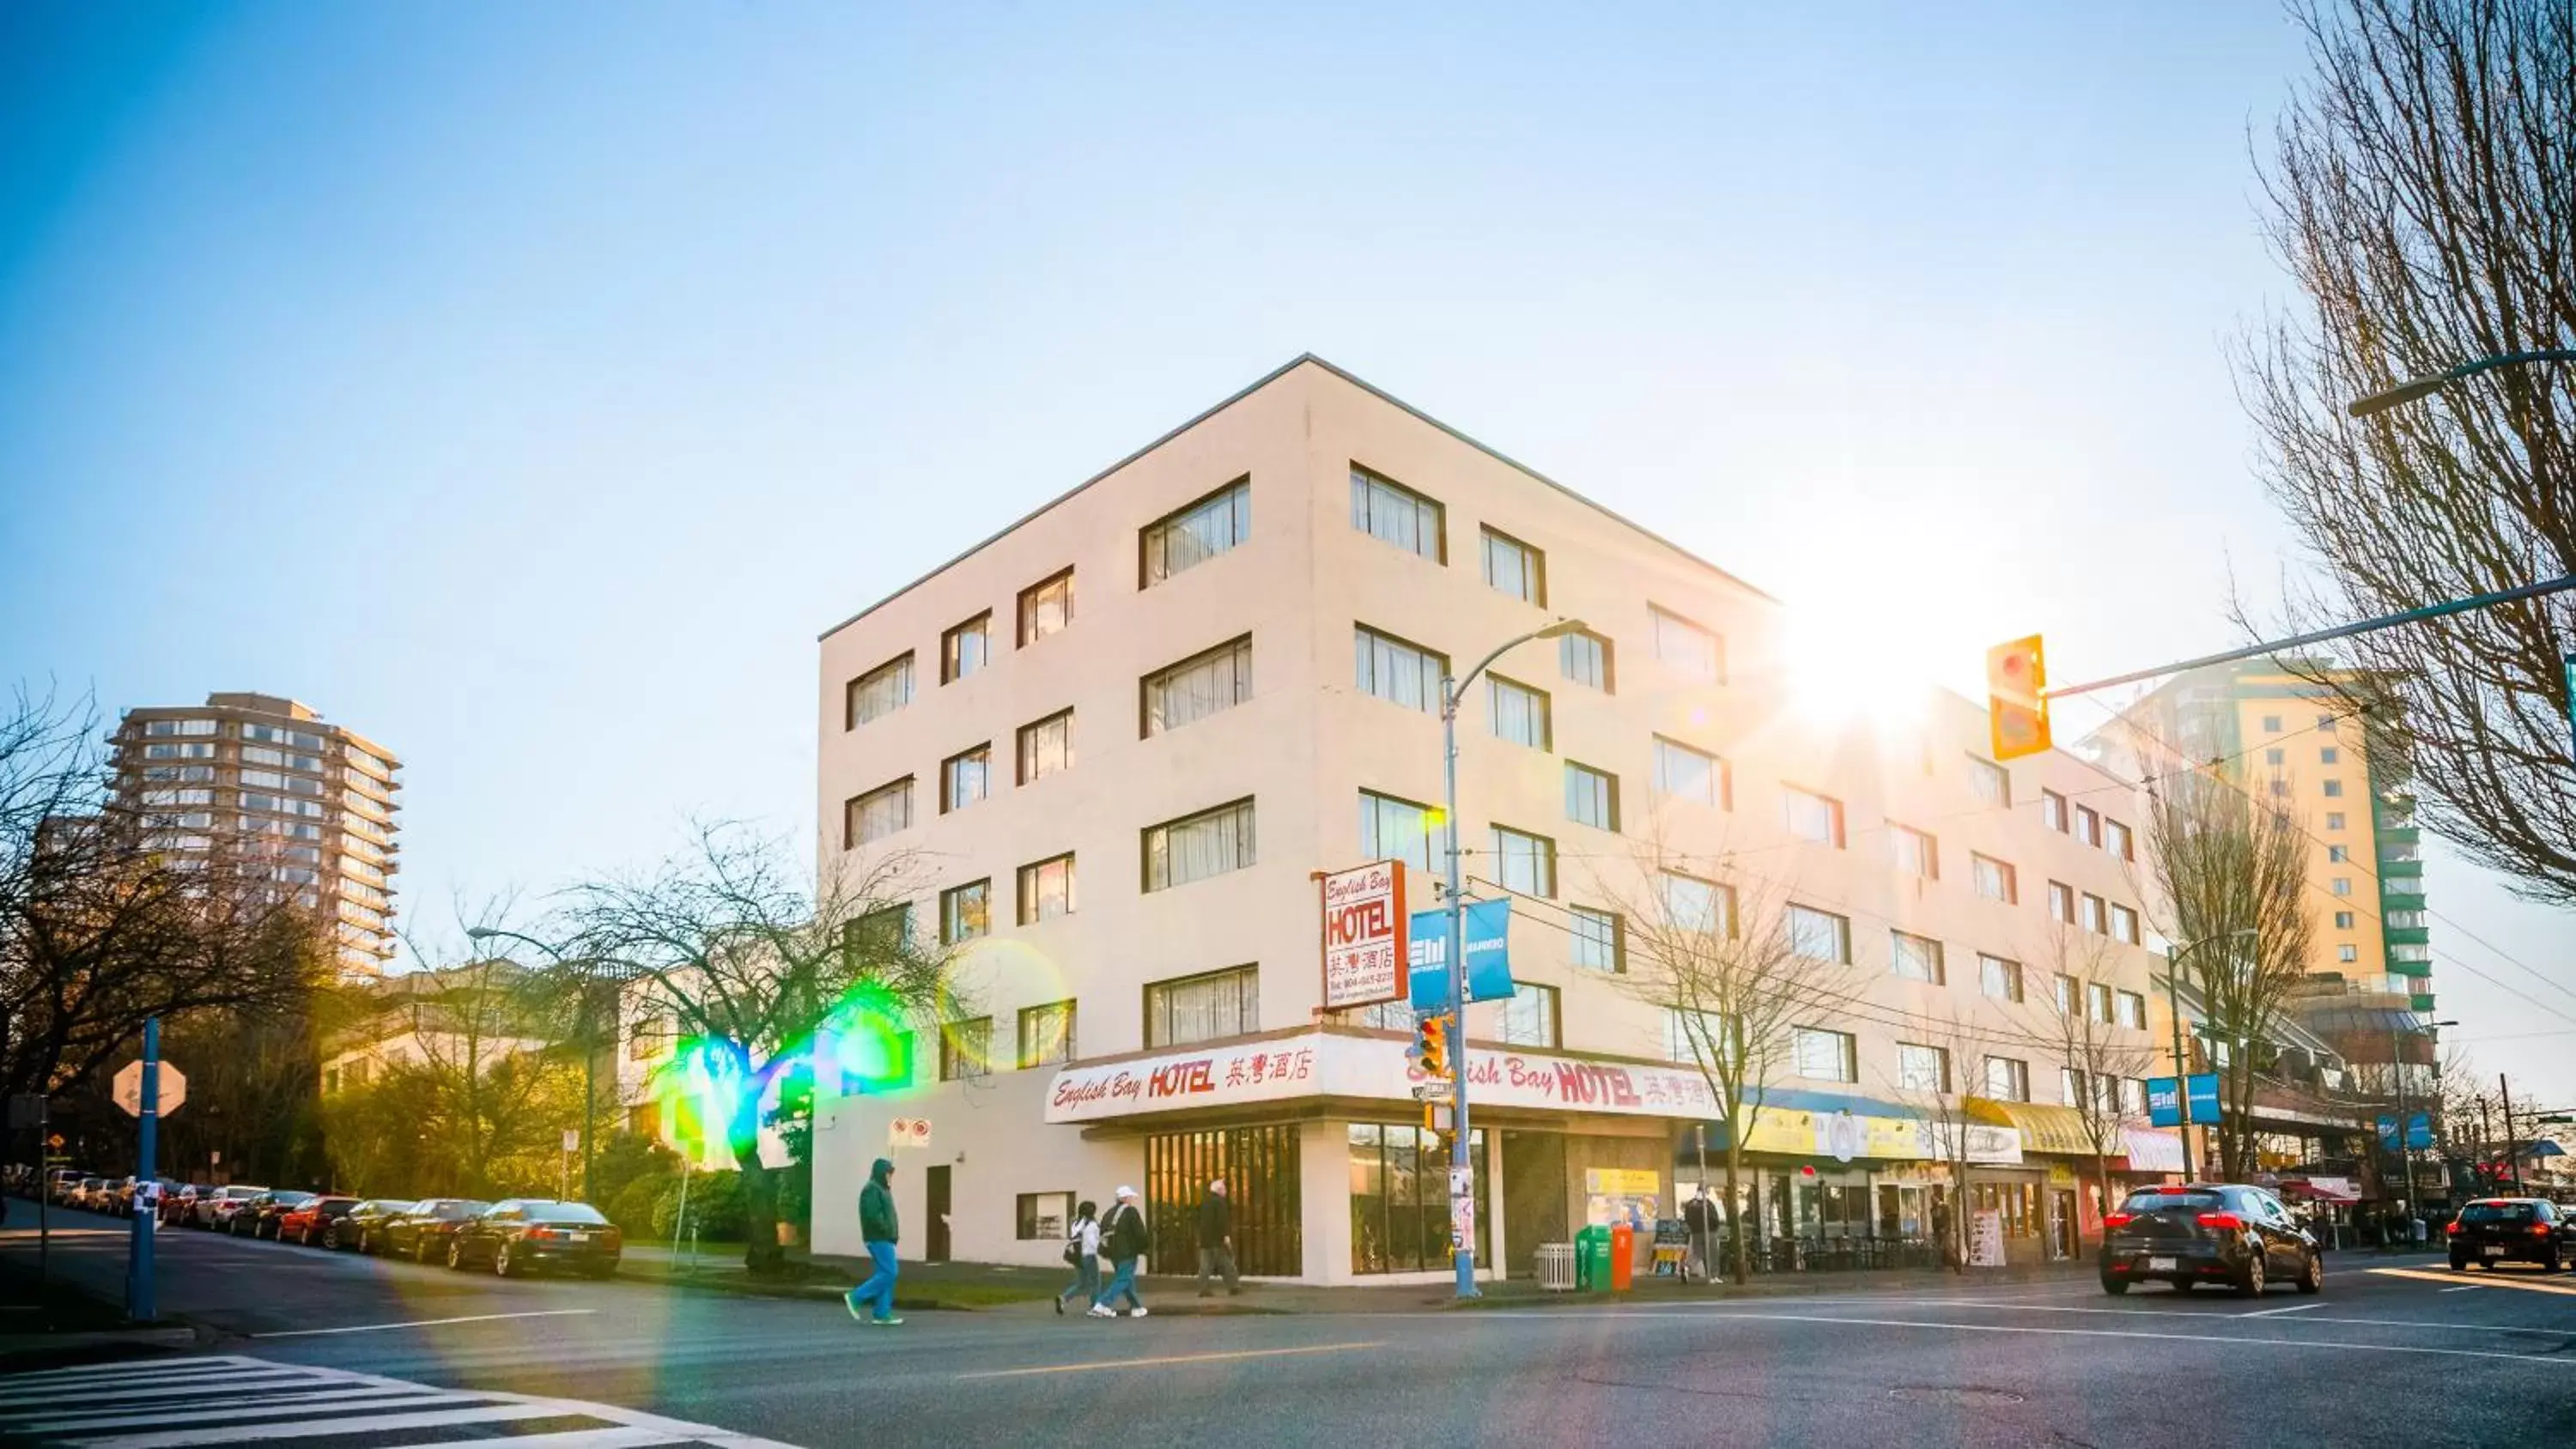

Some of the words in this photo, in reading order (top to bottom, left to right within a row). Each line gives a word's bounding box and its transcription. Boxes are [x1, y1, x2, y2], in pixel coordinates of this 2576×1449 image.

[1327, 876, 1367, 900] English
[1370, 870, 1390, 891] Bay
[1328, 900, 1392, 946] HOTEL
[1054, 1076, 1107, 1111] English
[1112, 1071, 1142, 1101] Bay
[1148, 1059, 1216, 1098] HOTEL
[1504, 1057, 1554, 1096] Bay
[1553, 1062, 1642, 1106] HOTEL
